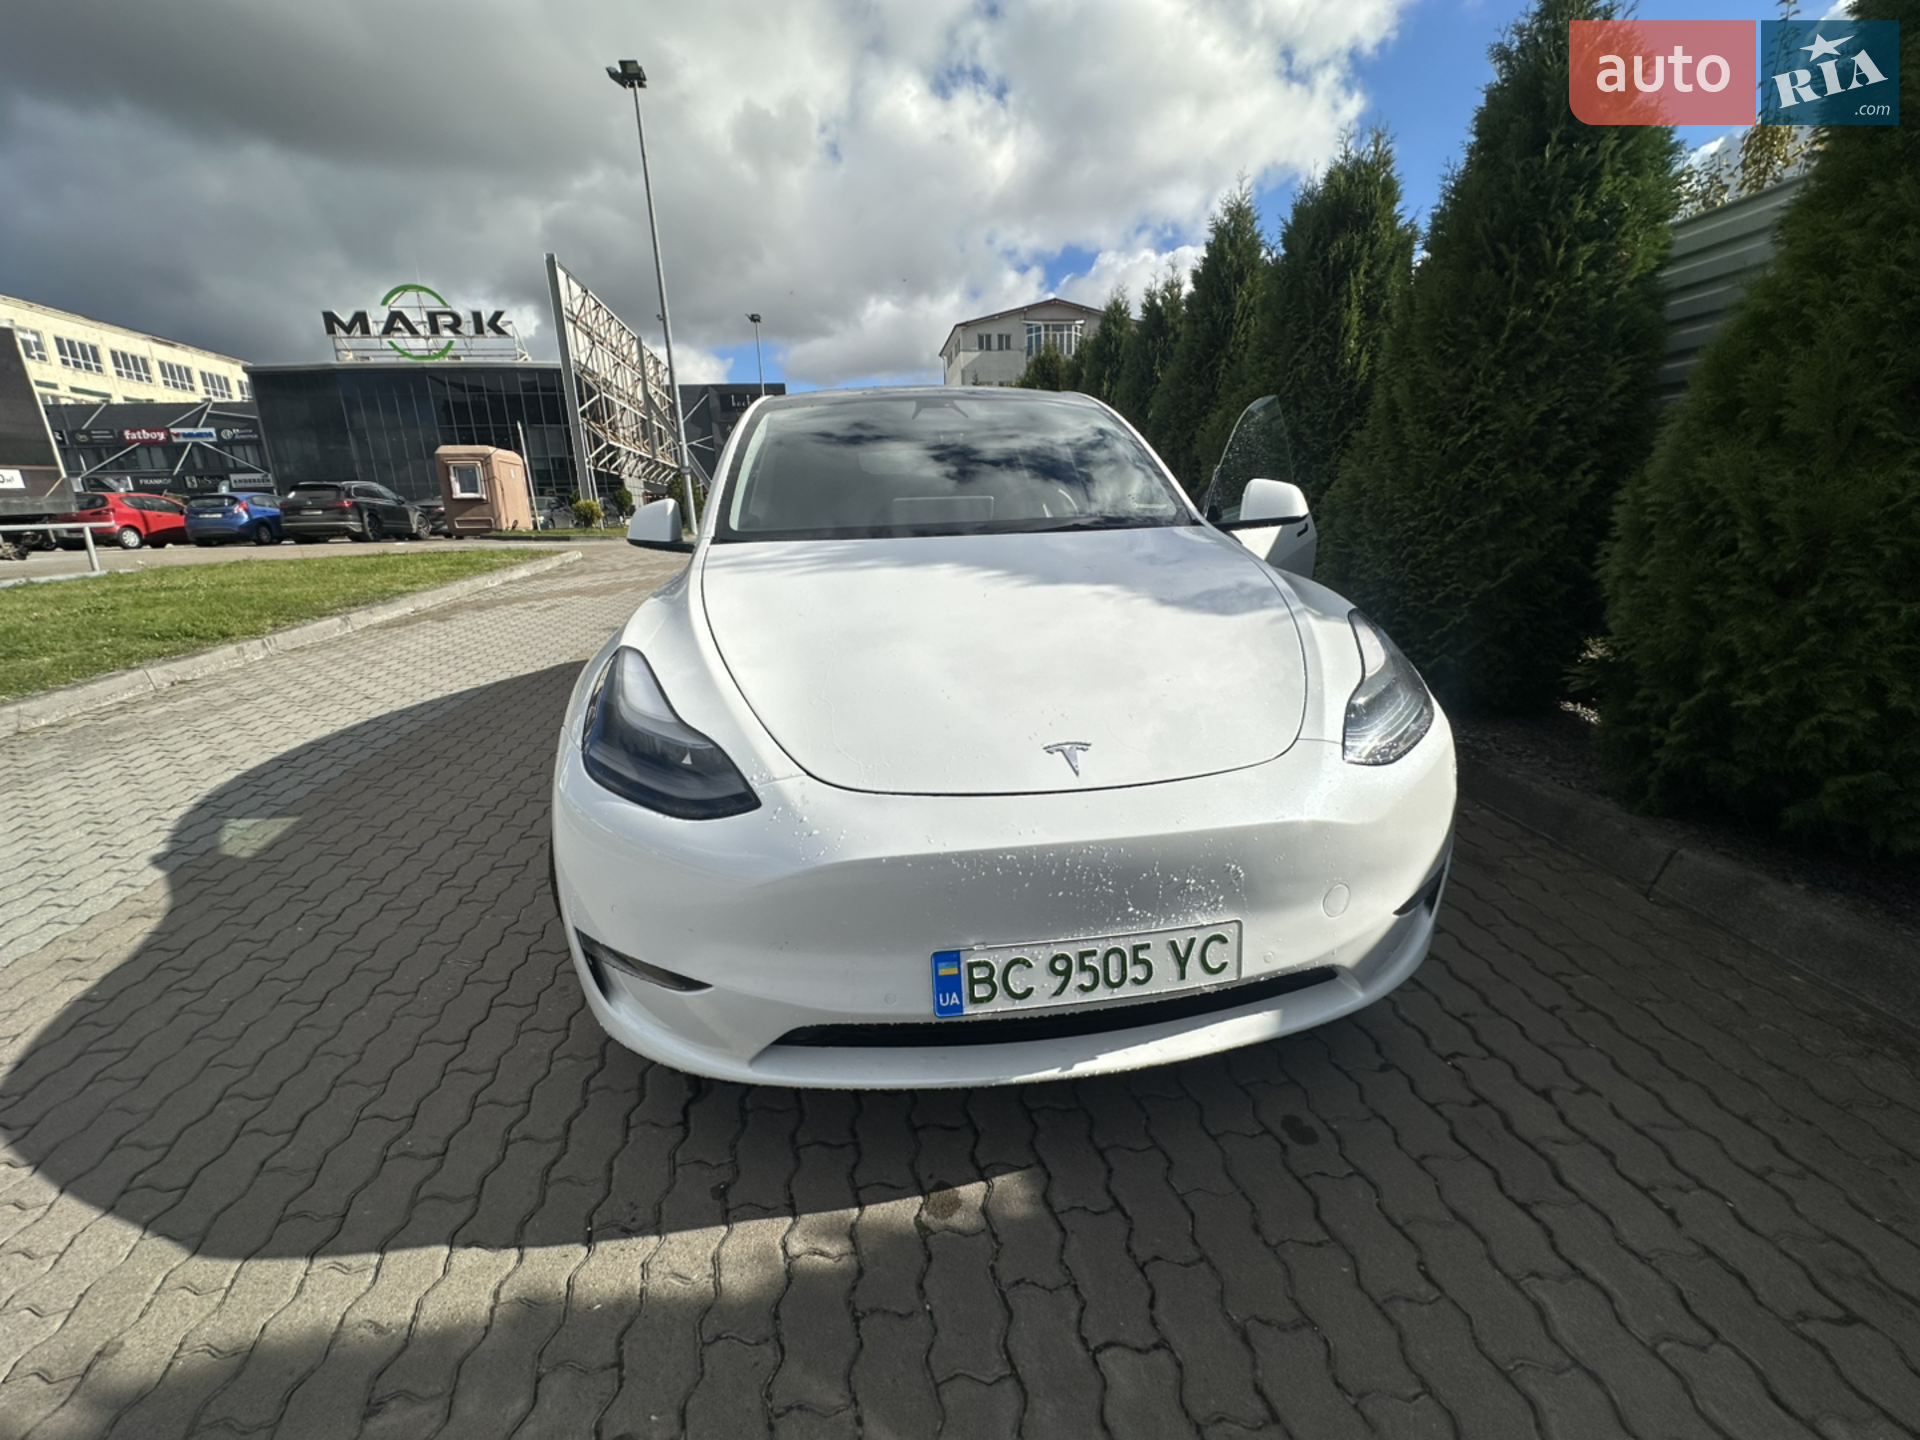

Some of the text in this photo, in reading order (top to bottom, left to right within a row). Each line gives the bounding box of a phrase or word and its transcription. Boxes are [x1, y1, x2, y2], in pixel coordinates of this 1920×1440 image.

[321, 310, 511, 336] MARK
[123, 428, 166, 441] fatboy
[967, 933, 1229, 1004] BC 9505 YC
[939, 993, 960, 1007] UA
